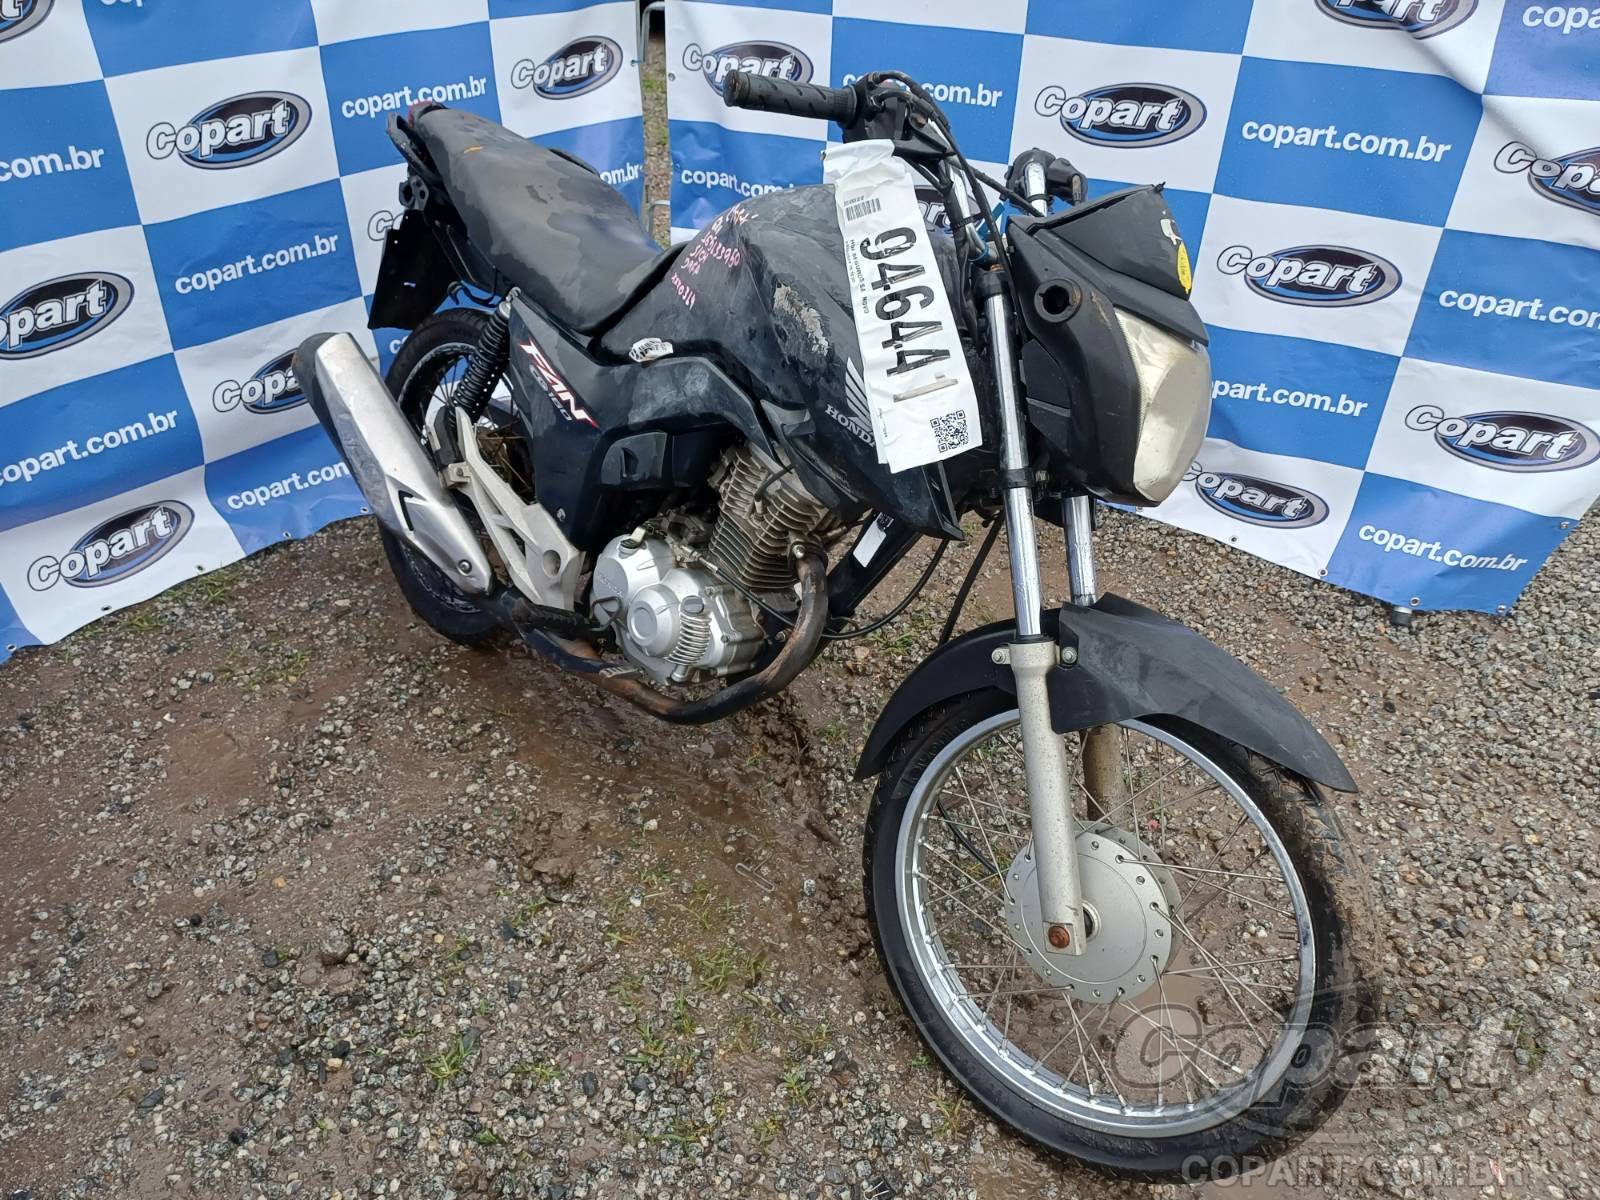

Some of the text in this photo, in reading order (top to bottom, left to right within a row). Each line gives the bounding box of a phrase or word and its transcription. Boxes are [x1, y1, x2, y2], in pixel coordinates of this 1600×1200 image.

[511, 42, 608, 90] Copart
[341, 75, 487, 118] copart.com.br
[1034, 86, 1184, 132] Copart
[147, 99, 293, 159] Copart
[1241, 118, 1452, 163] copart.com.br
[175, 234, 339, 294] copart.com.br
[1217, 245, 1378, 294] Copart
[520, 337, 598, 427] FAN
[1211, 380, 1369, 417] part.com.br
[1405, 405, 1579, 461] Copart
[27, 505, 174, 591] Copart
[1358, 525, 1529, 572] copart.com.br
